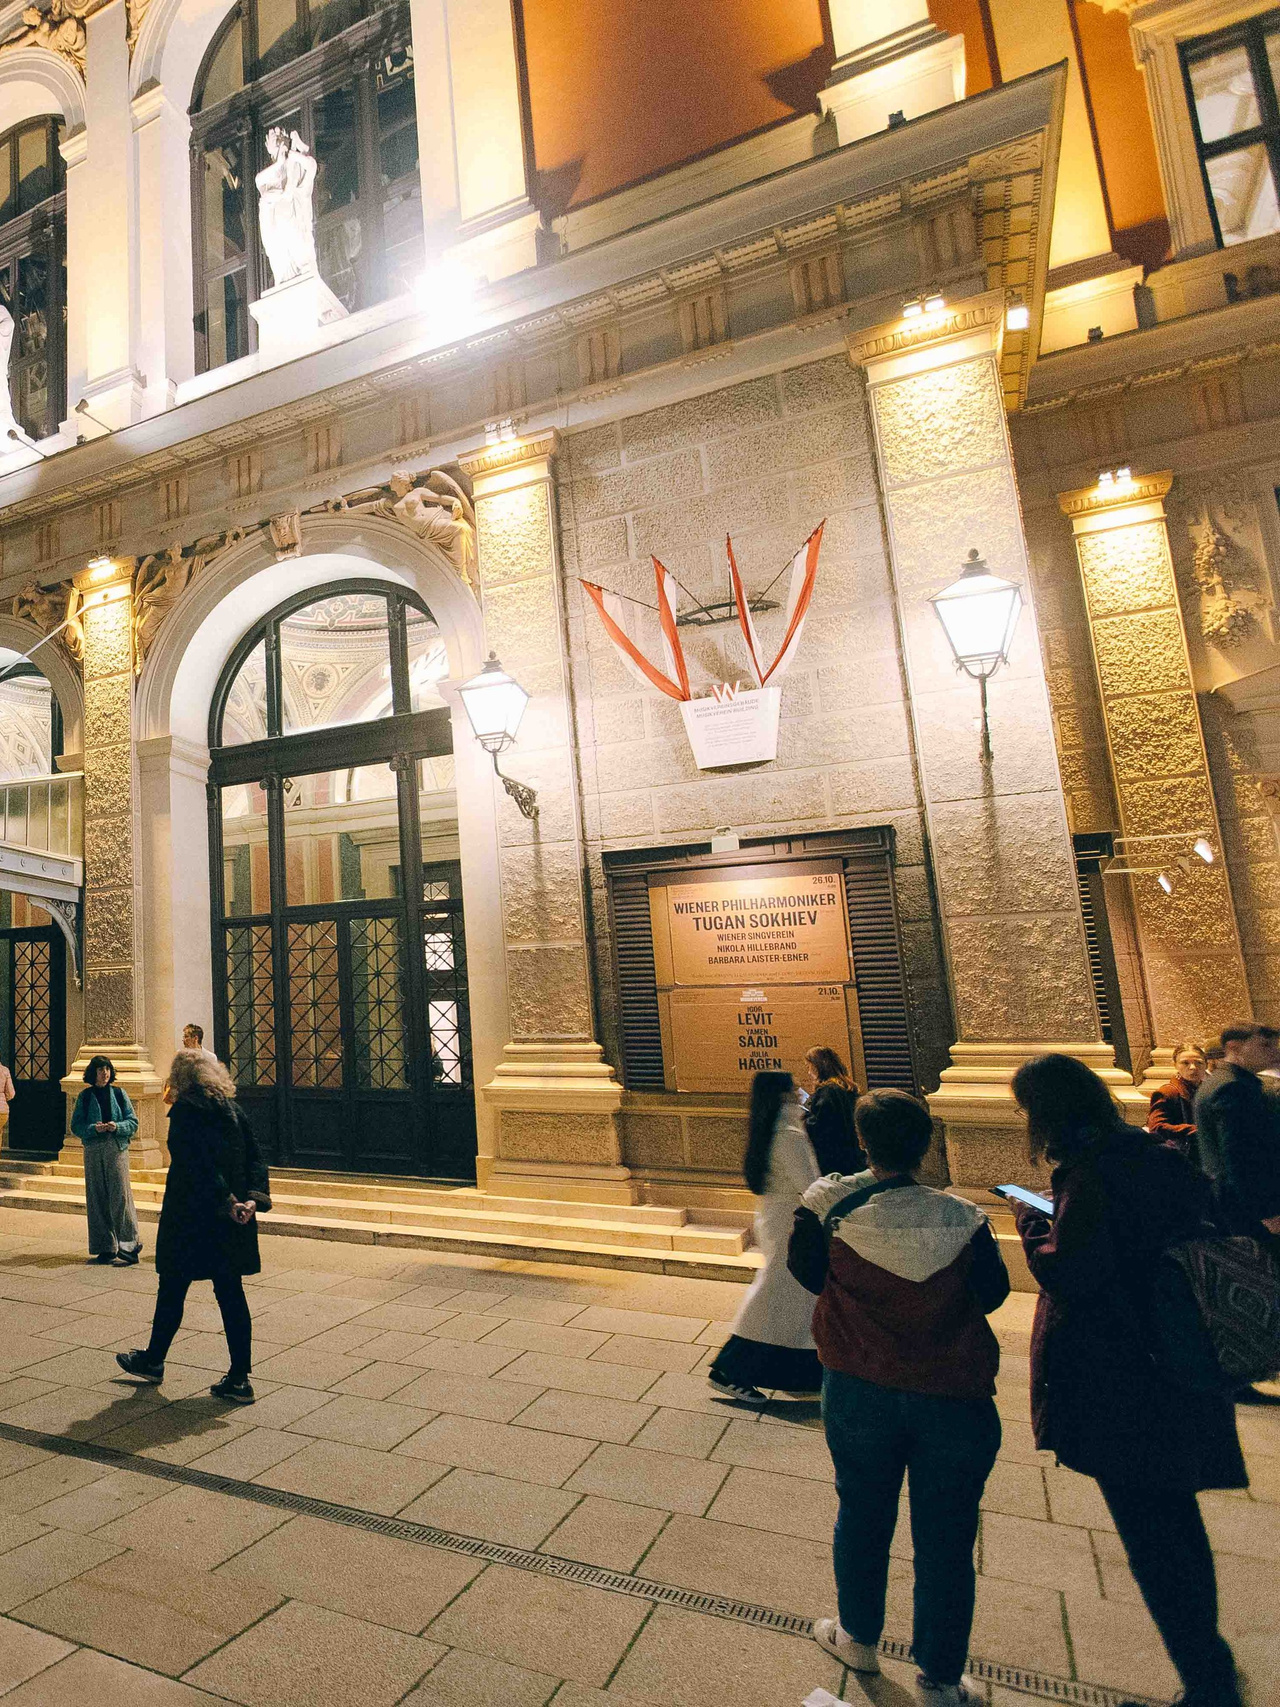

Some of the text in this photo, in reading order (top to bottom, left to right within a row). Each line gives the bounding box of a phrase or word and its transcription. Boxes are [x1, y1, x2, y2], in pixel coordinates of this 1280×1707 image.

[812, 875, 836, 885] 26.10.
[673, 893, 836, 915] WIENER PHILHARMONIKER
[693, 910, 817, 931] TUGAN SOKHIEV
[717, 930, 795, 942] WIENER SINGVEREIN
[717, 942, 797, 953] NIKOLA HILLEBRAND
[708, 953, 809, 965] BARBARA LAISTER-EBNER
[818, 987, 840, 996] 21.10.
[738, 1012, 773, 1025] LEVIT
[738, 1035, 778, 1048] SAADI
[738, 1058, 782, 1070] HAGEN
